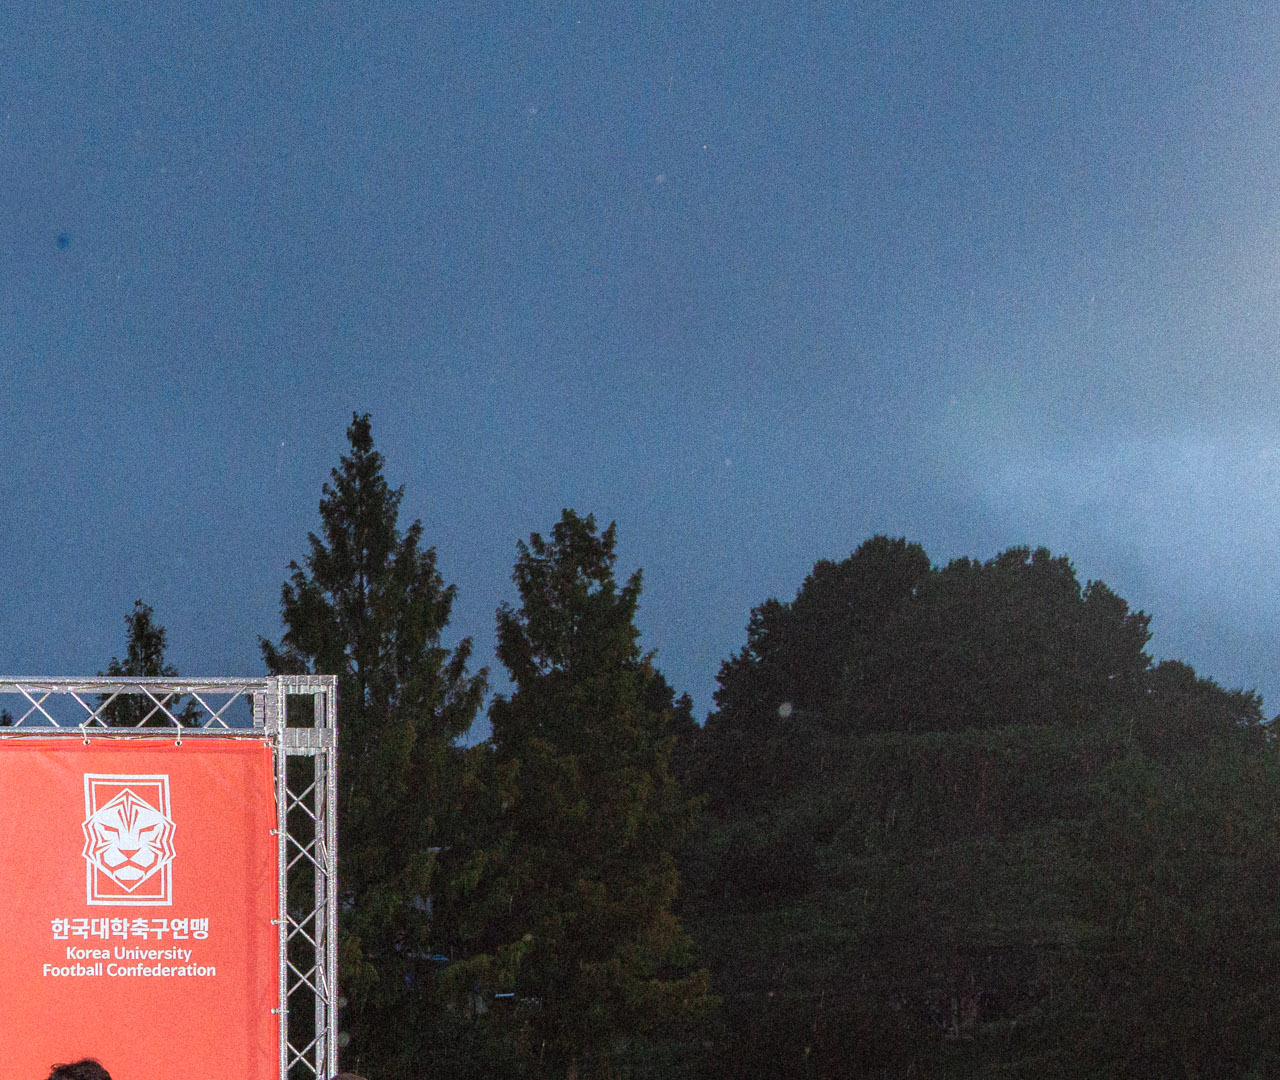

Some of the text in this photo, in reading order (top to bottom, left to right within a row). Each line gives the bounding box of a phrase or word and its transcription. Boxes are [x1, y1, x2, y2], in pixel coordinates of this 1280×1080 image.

[51, 917, 209, 940] 한국대학축구연맹
[66, 946, 192, 963] Korea University
[43, 963, 216, 977] Football Confederation
